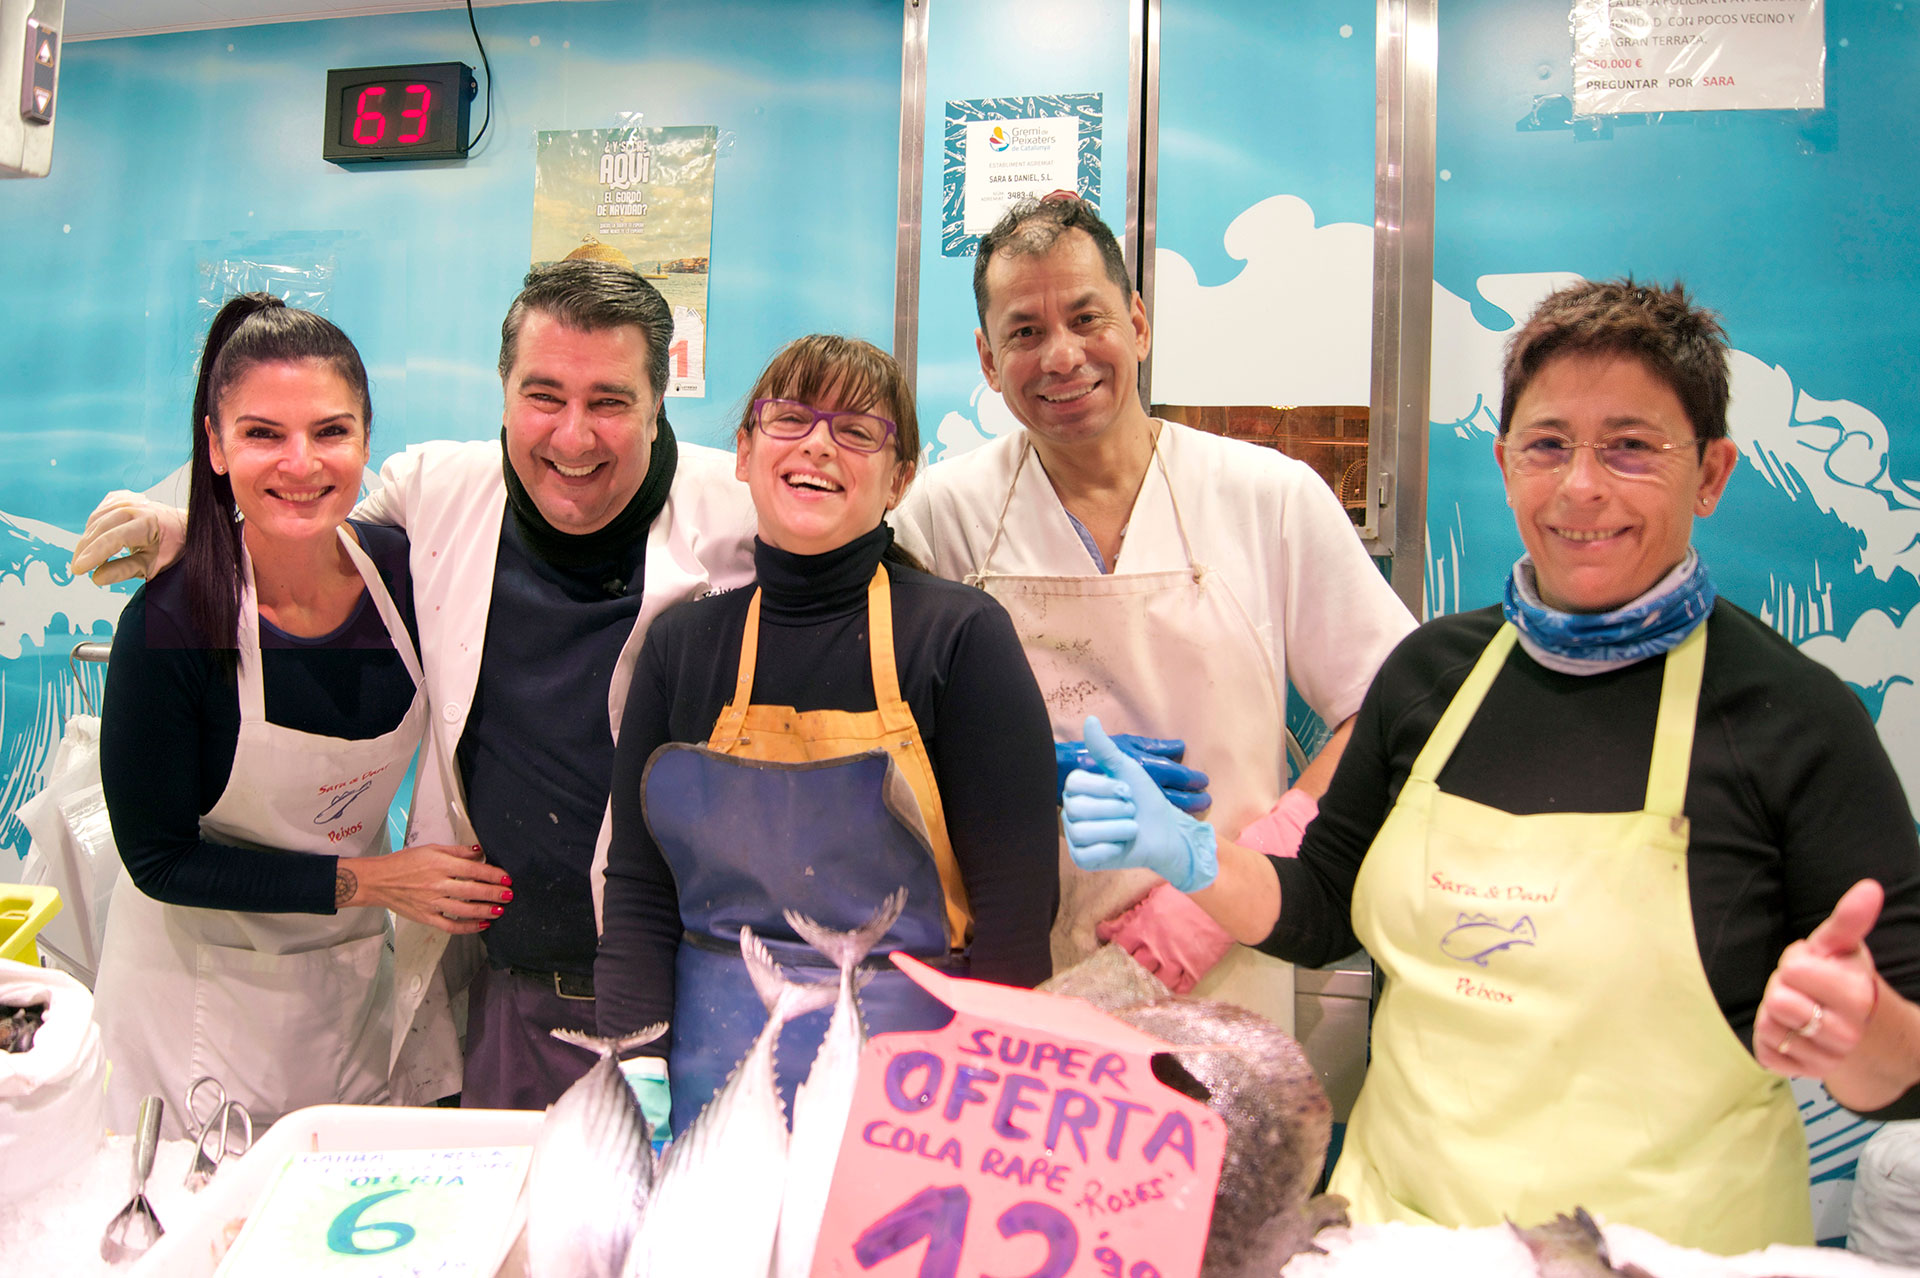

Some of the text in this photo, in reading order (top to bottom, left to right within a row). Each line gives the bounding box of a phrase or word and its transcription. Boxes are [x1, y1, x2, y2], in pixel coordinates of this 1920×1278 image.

[1668, 16, 1693, 27] CON
[1697, 14, 1738, 25] POCOS
[1741, 13, 1785, 24] VECINO
[1787, 13, 1795, 24] Y
[1615, 37, 1648, 47] GRAN
[1635, 58, 1643, 68] €
[1586, 76, 1735, 90] PREGUNTAR POR SARA
[353, 84, 431, 144] 63
[1012, 126, 1041, 136] Gremi
[1012, 135, 1056, 146] Peixaters
[599, 152, 650, 190] AQUÍ
[989, 173, 1053, 183] SARA & DANIEL, S.L.
[604, 190, 642, 203] EL GORDO
[597, 203, 648, 216] DE NAVIDAD?
[328, 821, 363, 843] Peixos
[1429, 871, 1477, 897] Sara
[958, 1029, 1130, 1092] SUPER
[885, 1050, 1196, 1171] OFERTA
[863, 1121, 962, 1168] COLA
[981, 1148, 1071, 1193] RAPE
[327, 1189, 416, 1255] 6
